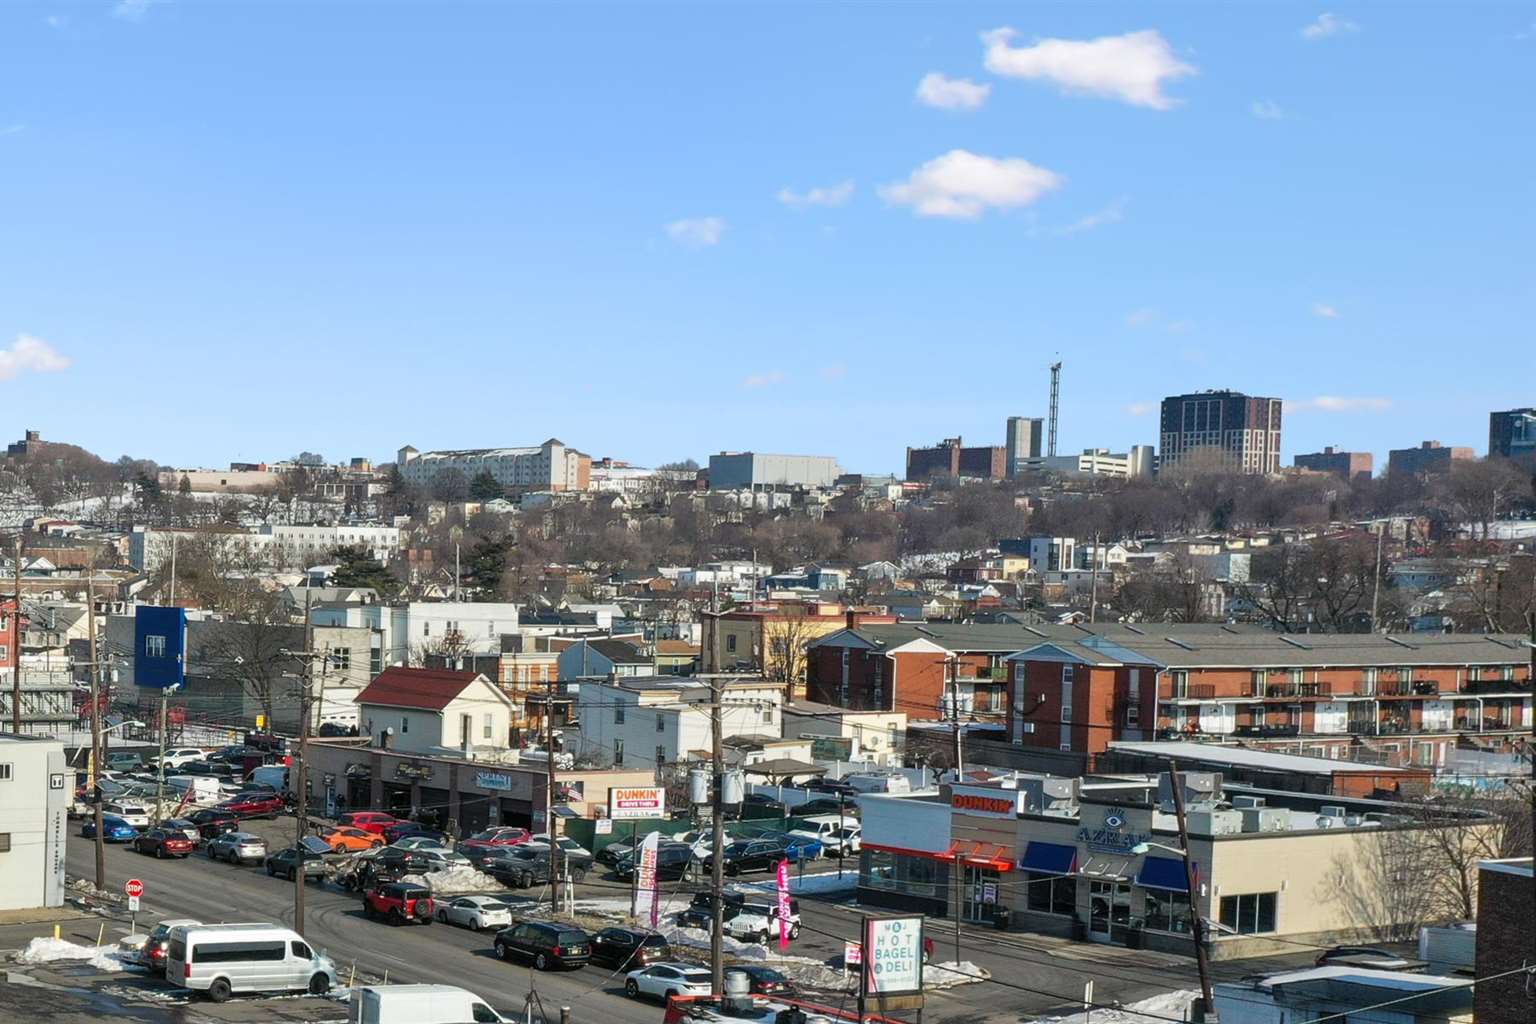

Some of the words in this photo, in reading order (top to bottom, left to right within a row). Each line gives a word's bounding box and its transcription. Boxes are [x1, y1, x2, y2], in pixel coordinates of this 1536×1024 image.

[616, 789, 660, 800] DUNKIN'
[952, 794, 1014, 813] DUNKIN'
[877, 934, 912, 946] HOT
[875, 947, 914, 960] BAGEL
[886, 961, 913, 973] DELI
